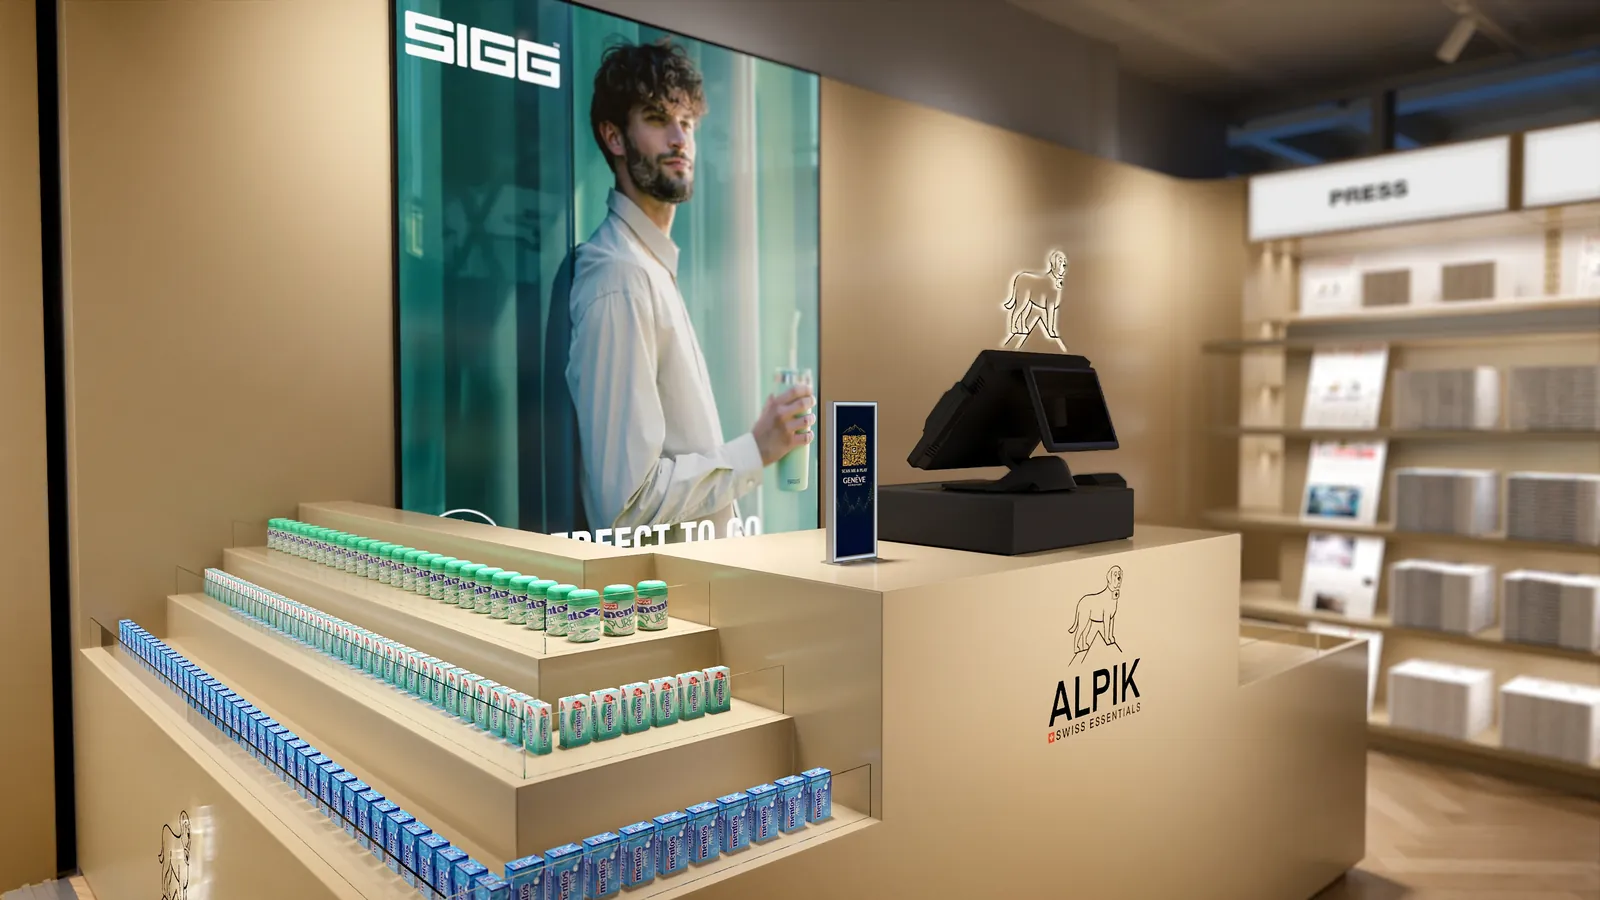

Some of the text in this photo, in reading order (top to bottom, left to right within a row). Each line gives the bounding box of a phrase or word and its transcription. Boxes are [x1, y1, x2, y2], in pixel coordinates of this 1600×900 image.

[405, 10, 560, 89] SIGG
[1328, 179, 1408, 208] PRESS
[680, 519, 715, 543] TO
[726, 515, 762, 538] GO
[1048, 658, 1140, 728] ALPIK
[1056, 702, 1140, 740] SWISS ESSENTIALS
[598, 858, 608, 894] mentos
[634, 846, 642, 882] mentos
[561, 870, 570, 900] entos
